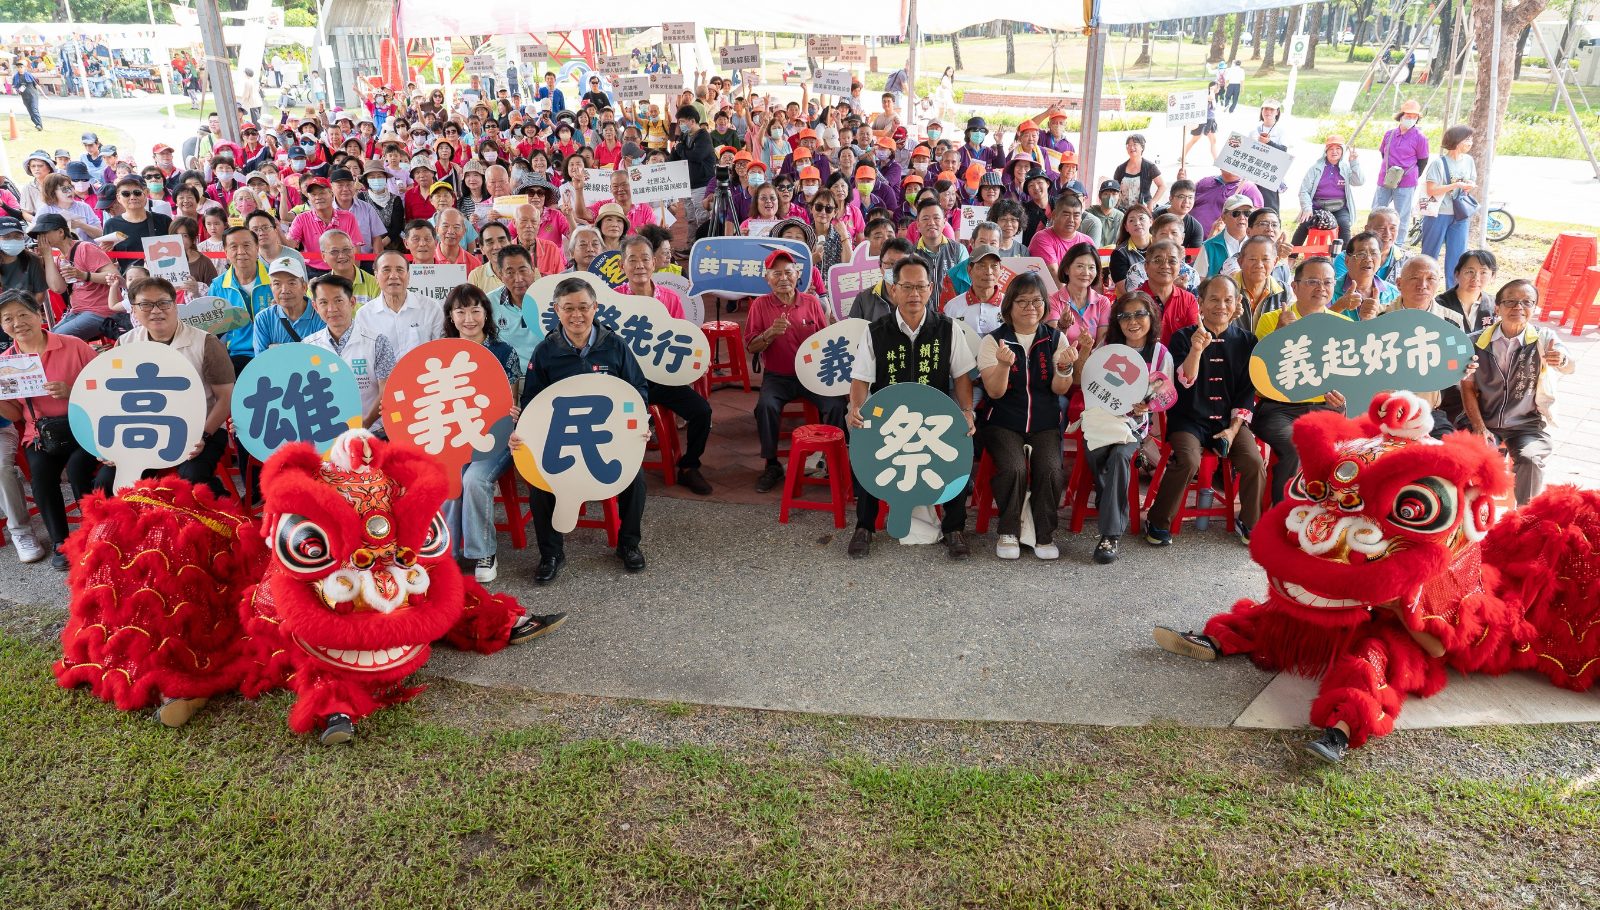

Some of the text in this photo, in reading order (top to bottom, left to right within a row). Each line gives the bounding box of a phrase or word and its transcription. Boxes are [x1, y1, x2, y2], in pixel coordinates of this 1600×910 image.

[647, 175, 673, 185] 社團法人
[1276, 326, 1441, 391] 義起好市
[98, 362, 191, 462] 高
[243, 369, 349, 450] 雄
[407, 350, 495, 456] 義
[540, 394, 623, 485] 民
[874, 404, 959, 492] 祭
